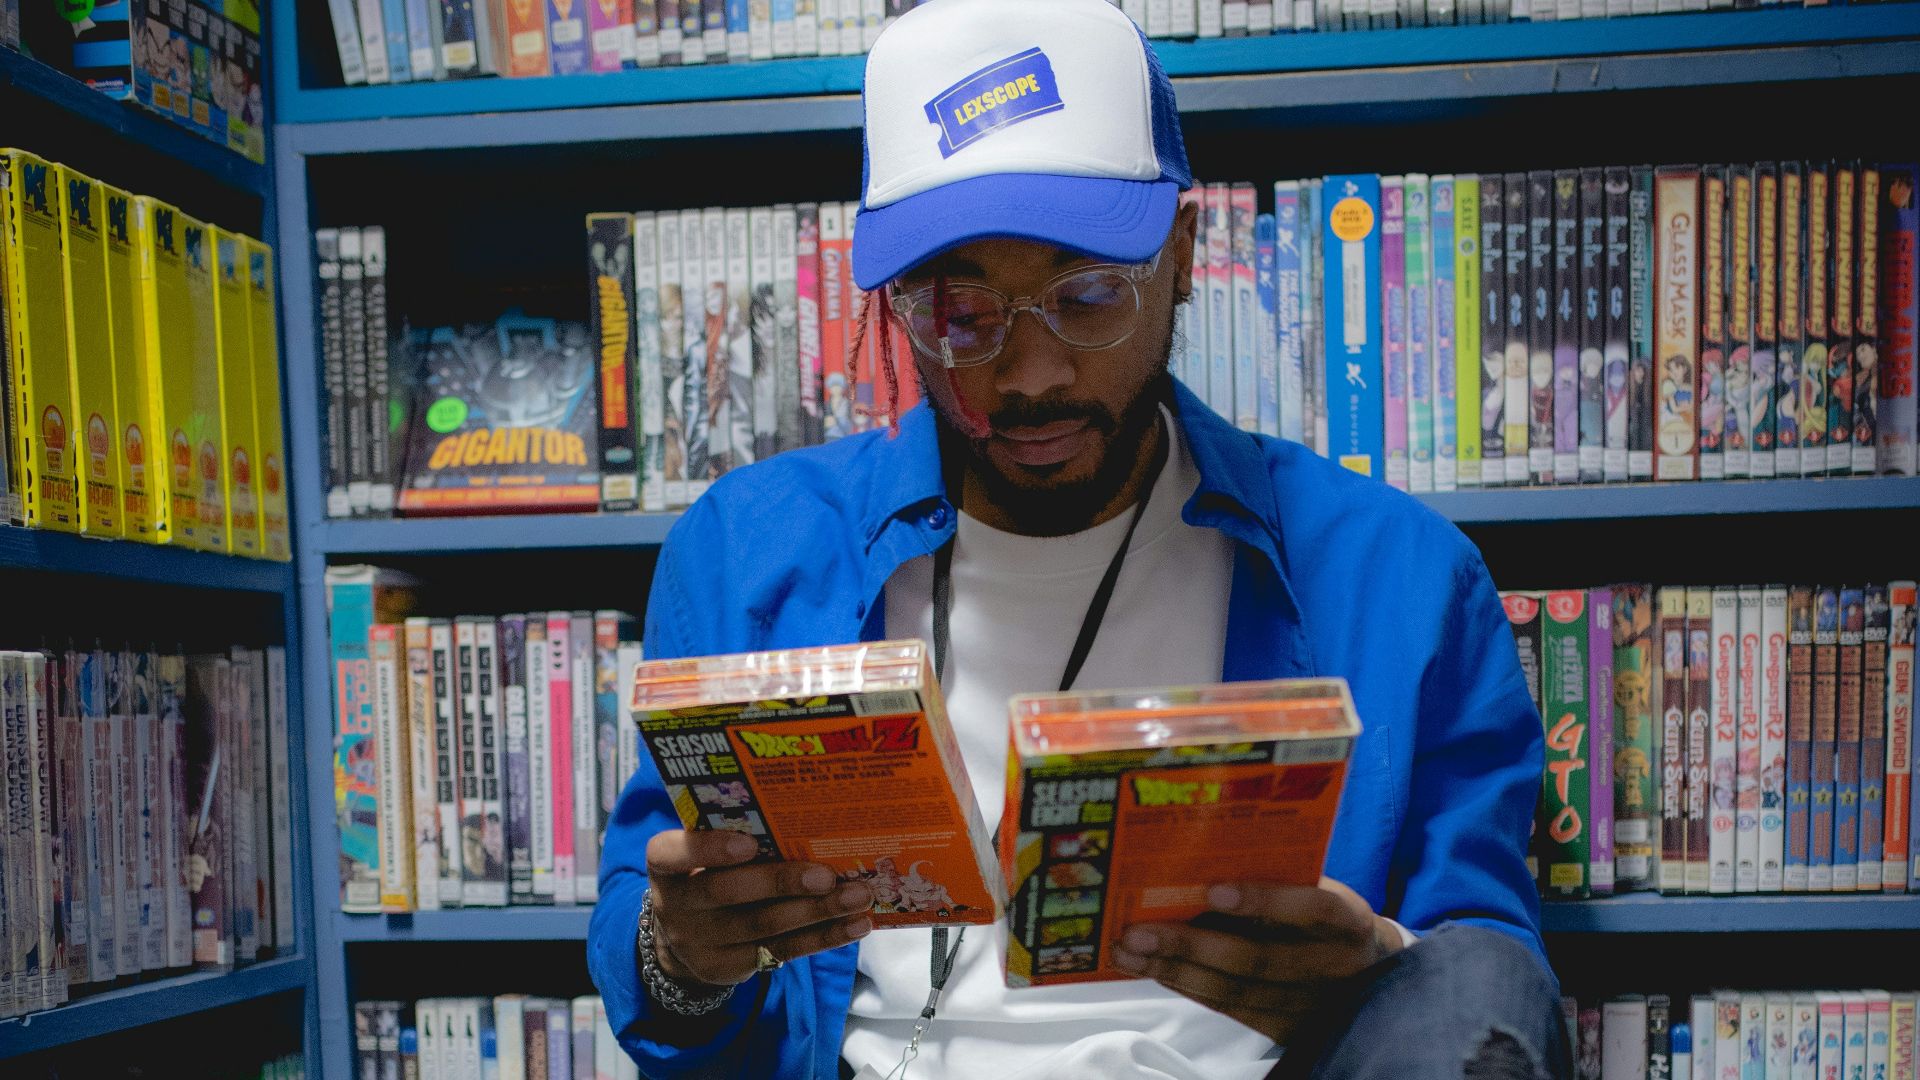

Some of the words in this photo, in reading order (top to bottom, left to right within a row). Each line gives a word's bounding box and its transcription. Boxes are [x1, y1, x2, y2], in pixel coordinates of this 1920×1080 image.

[953, 73, 1040, 126] LEXSCOPE
[1671, 212, 1691, 277] GLASS
[822, 248, 843, 320] GINTAMA
[1487, 289, 1497, 325] 1
[1510, 293, 1523, 327] 2
[1535, 286, 1548, 322] 3
[1559, 287, 1573, 322] 4
[1586, 286, 1600, 322] 5
[1610, 286, 1623, 321] 6
[1673, 279, 1690, 341] MASK
[599, 274, 629, 371] GIGANTOR
[428, 426, 588, 470] GIGANTOR
[1791, 631, 1812, 644] DVD
[1817, 631, 1838, 644] DVD
[1840, 631, 1863, 645] DVD
[1865, 627, 1887, 641] DVD
[1714, 632, 1734, 729] GUNBUSTER
[1739, 632, 1758, 728] GUNBUSTER
[1764, 632, 1785, 728] GUNBUSTER
[1895, 660, 1910, 694] GUN
[653, 731, 731, 758] SEASON
[872, 717, 921, 753] Z
[1718, 729, 1734, 743] 2
[1742, 729, 1758, 742] 2
[1767, 729, 1784, 742] 2
[1892, 705, 1908, 769] SWORD
[663, 755, 711, 779] NINE
[1547, 712, 1586, 844] GTO
[535, 755, 547, 862] PROFESSIONAL
